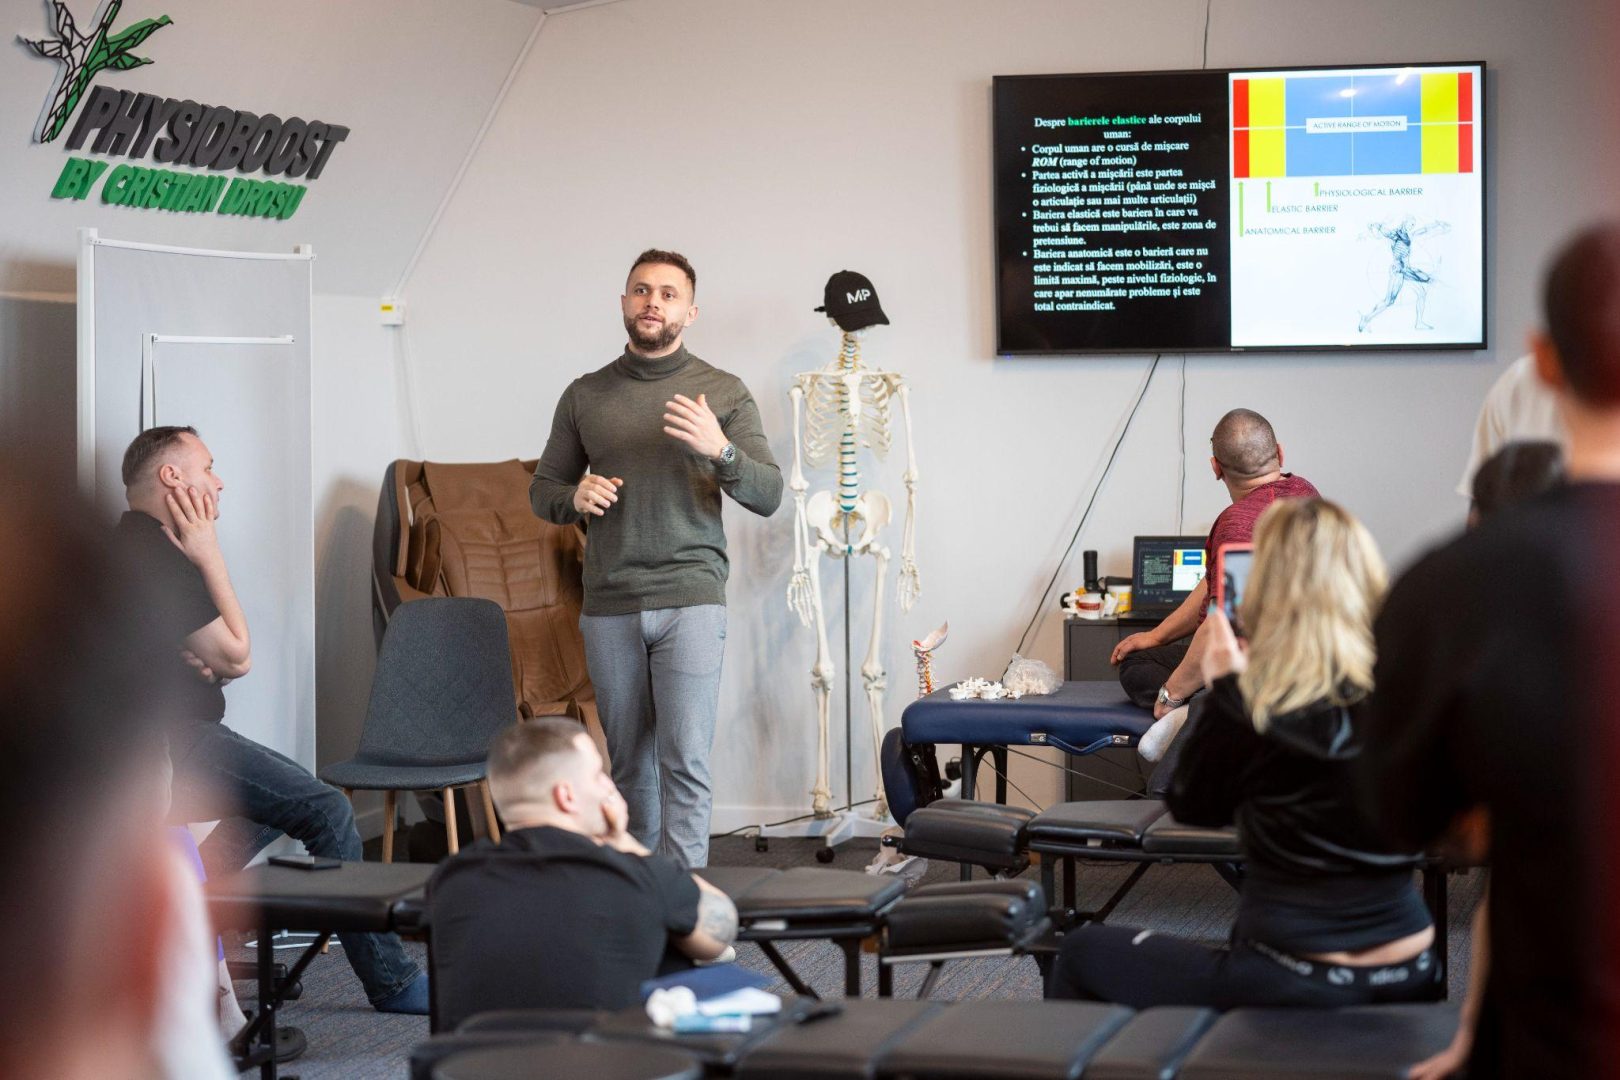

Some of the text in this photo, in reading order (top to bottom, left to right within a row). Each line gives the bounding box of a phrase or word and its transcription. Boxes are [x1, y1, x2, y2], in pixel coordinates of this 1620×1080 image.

[1035, 114, 1201, 128] Despre barierele elastice ale corpului
[65, 84, 350, 180] PHYSIOBOOST
[1104, 130, 1131, 139] uman:
[1032, 144, 1062, 155] Corpul
[1142, 142, 1152, 150] de
[1032, 155, 1136, 167] ROM (range of motion)
[1032, 171, 1060, 180] Partea
[1155, 169, 1183, 179] partea
[51, 157, 109, 200] BY
[100, 164, 229, 213] CRISTIAN
[1154, 181, 1175, 190] unde
[1320, 189, 1387, 197] PHYSIOLOGICAL
[1104, 196, 1121, 204] mai
[1123, 195, 1148, 204] multe
[1033, 210, 1065, 219] Bariera
[1122, 209, 1152, 217] bariera
[1272, 204, 1338, 213] ELASTIC BARRIER
[1033, 223, 1058, 232] trebui
[1073, 223, 1099, 231] facem
[1205, 220, 1216, 229] de
[1245, 226, 1336, 235] ANATOMICAL BARRIER
[1033, 236, 1086, 247] pretensiune.
[1034, 250, 1065, 259] Bariera
[1053, 262, 1083, 271] indicat
[1098, 261, 1124, 270] facem
[1102, 276, 1124, 286] peste
[1127, 274, 1158, 283] nivelul
[1160, 273, 1205, 284] fiziologic,
[846, 288, 871, 304] MP
[1055, 290, 1074, 299] apar
[1129, 288, 1170, 298] probleme
[1034, 301, 1115, 311] total contraindicat.
